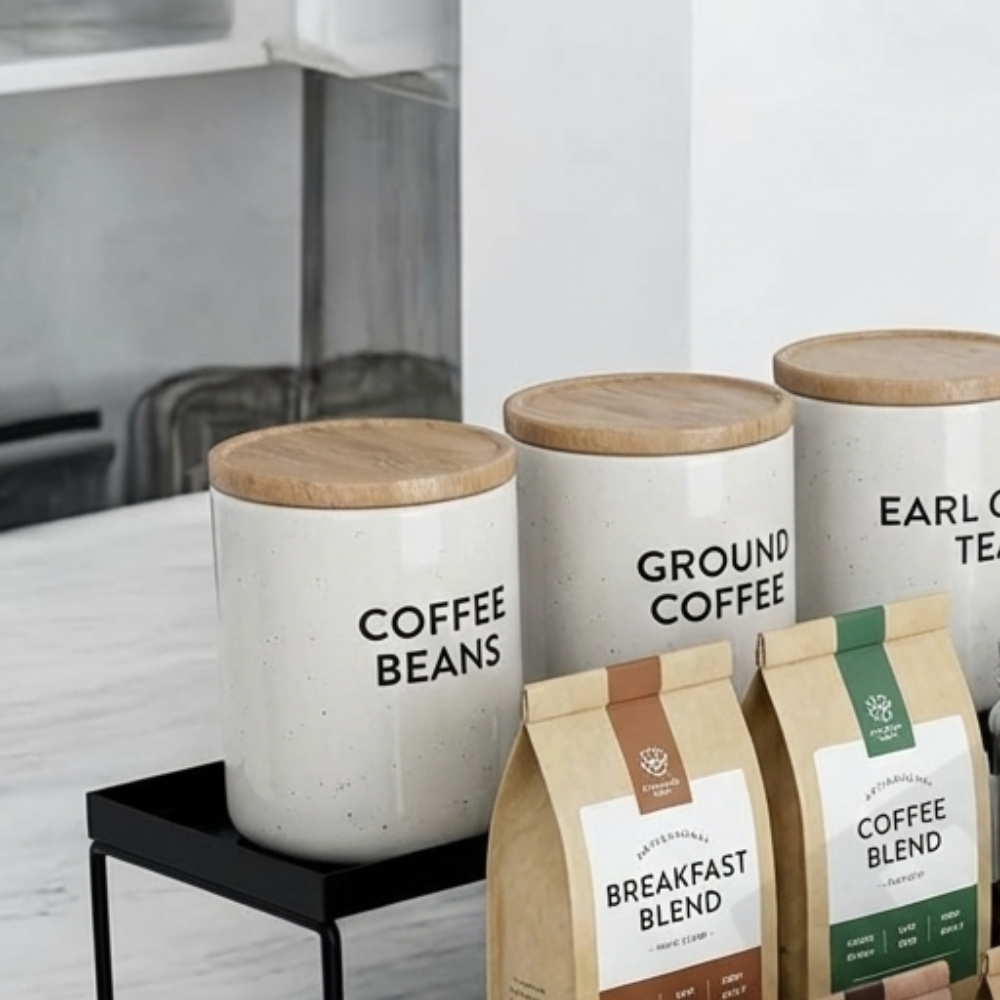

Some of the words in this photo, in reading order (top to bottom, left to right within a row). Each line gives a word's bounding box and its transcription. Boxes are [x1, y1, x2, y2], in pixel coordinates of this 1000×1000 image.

[880, 494, 979, 527] EARL
[637, 528, 789, 583] GROUND
[358, 584, 506, 642] COFFEE
[651, 572, 785, 626] COFFEE
[377, 633, 501, 686] BEANS
[857, 797, 947, 840] COFFEE
[867, 830, 942, 869] BLEND
[606, 849, 747, 908] BREAKFAST
[639, 889, 722, 932] BLEND
